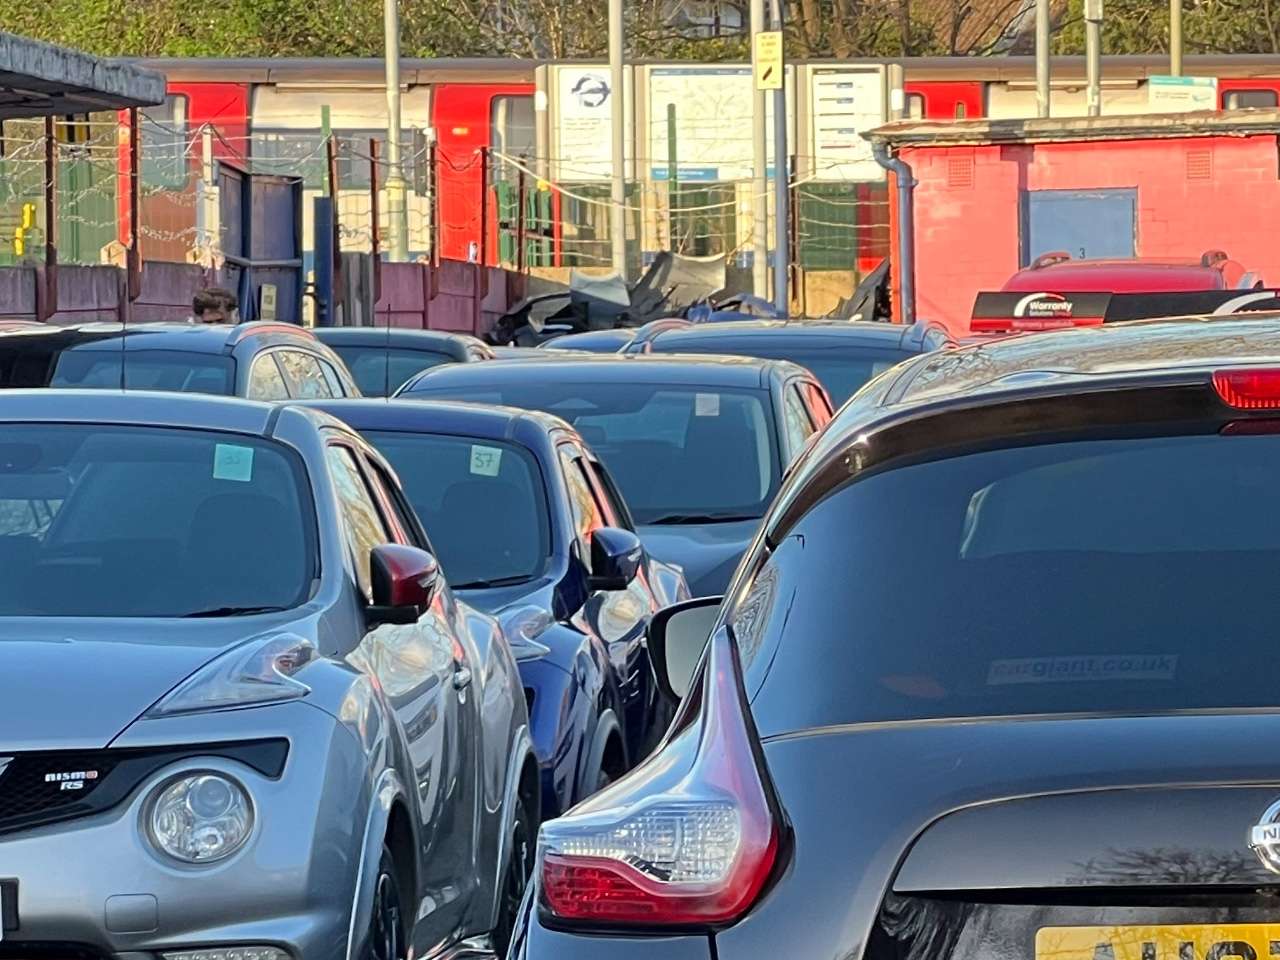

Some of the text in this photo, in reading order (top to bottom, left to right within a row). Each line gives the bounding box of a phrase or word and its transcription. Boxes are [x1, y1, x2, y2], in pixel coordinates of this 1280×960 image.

[1079, 247, 1086, 260] 3
[44, 770, 99, 783] nismo
[60, 780, 84, 791] RS
